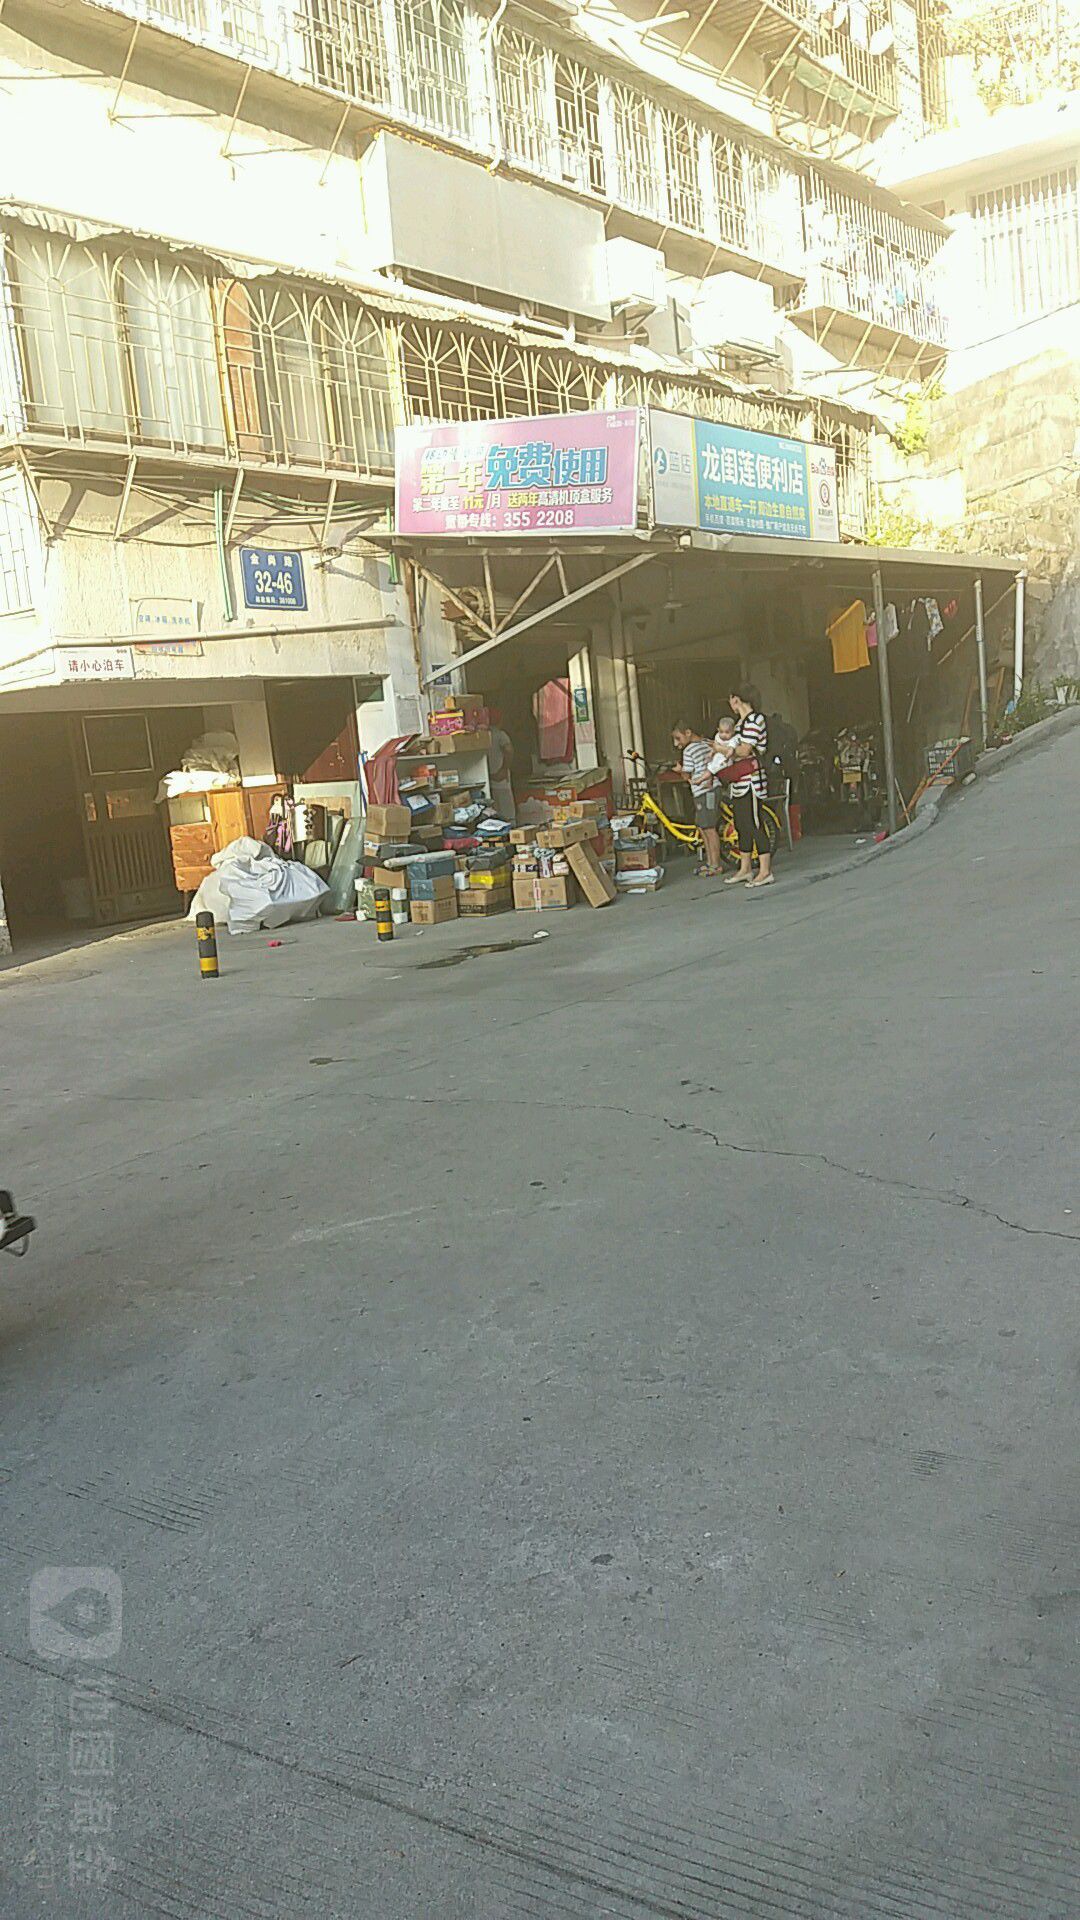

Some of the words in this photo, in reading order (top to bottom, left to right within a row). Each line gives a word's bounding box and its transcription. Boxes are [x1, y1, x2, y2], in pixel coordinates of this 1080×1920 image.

[503, 511, 531, 528] 355
[536, 509, 574, 526] 2208
[254, 570, 293, 594] 32-46
[68, 659, 125, 672] 请小心泊车
